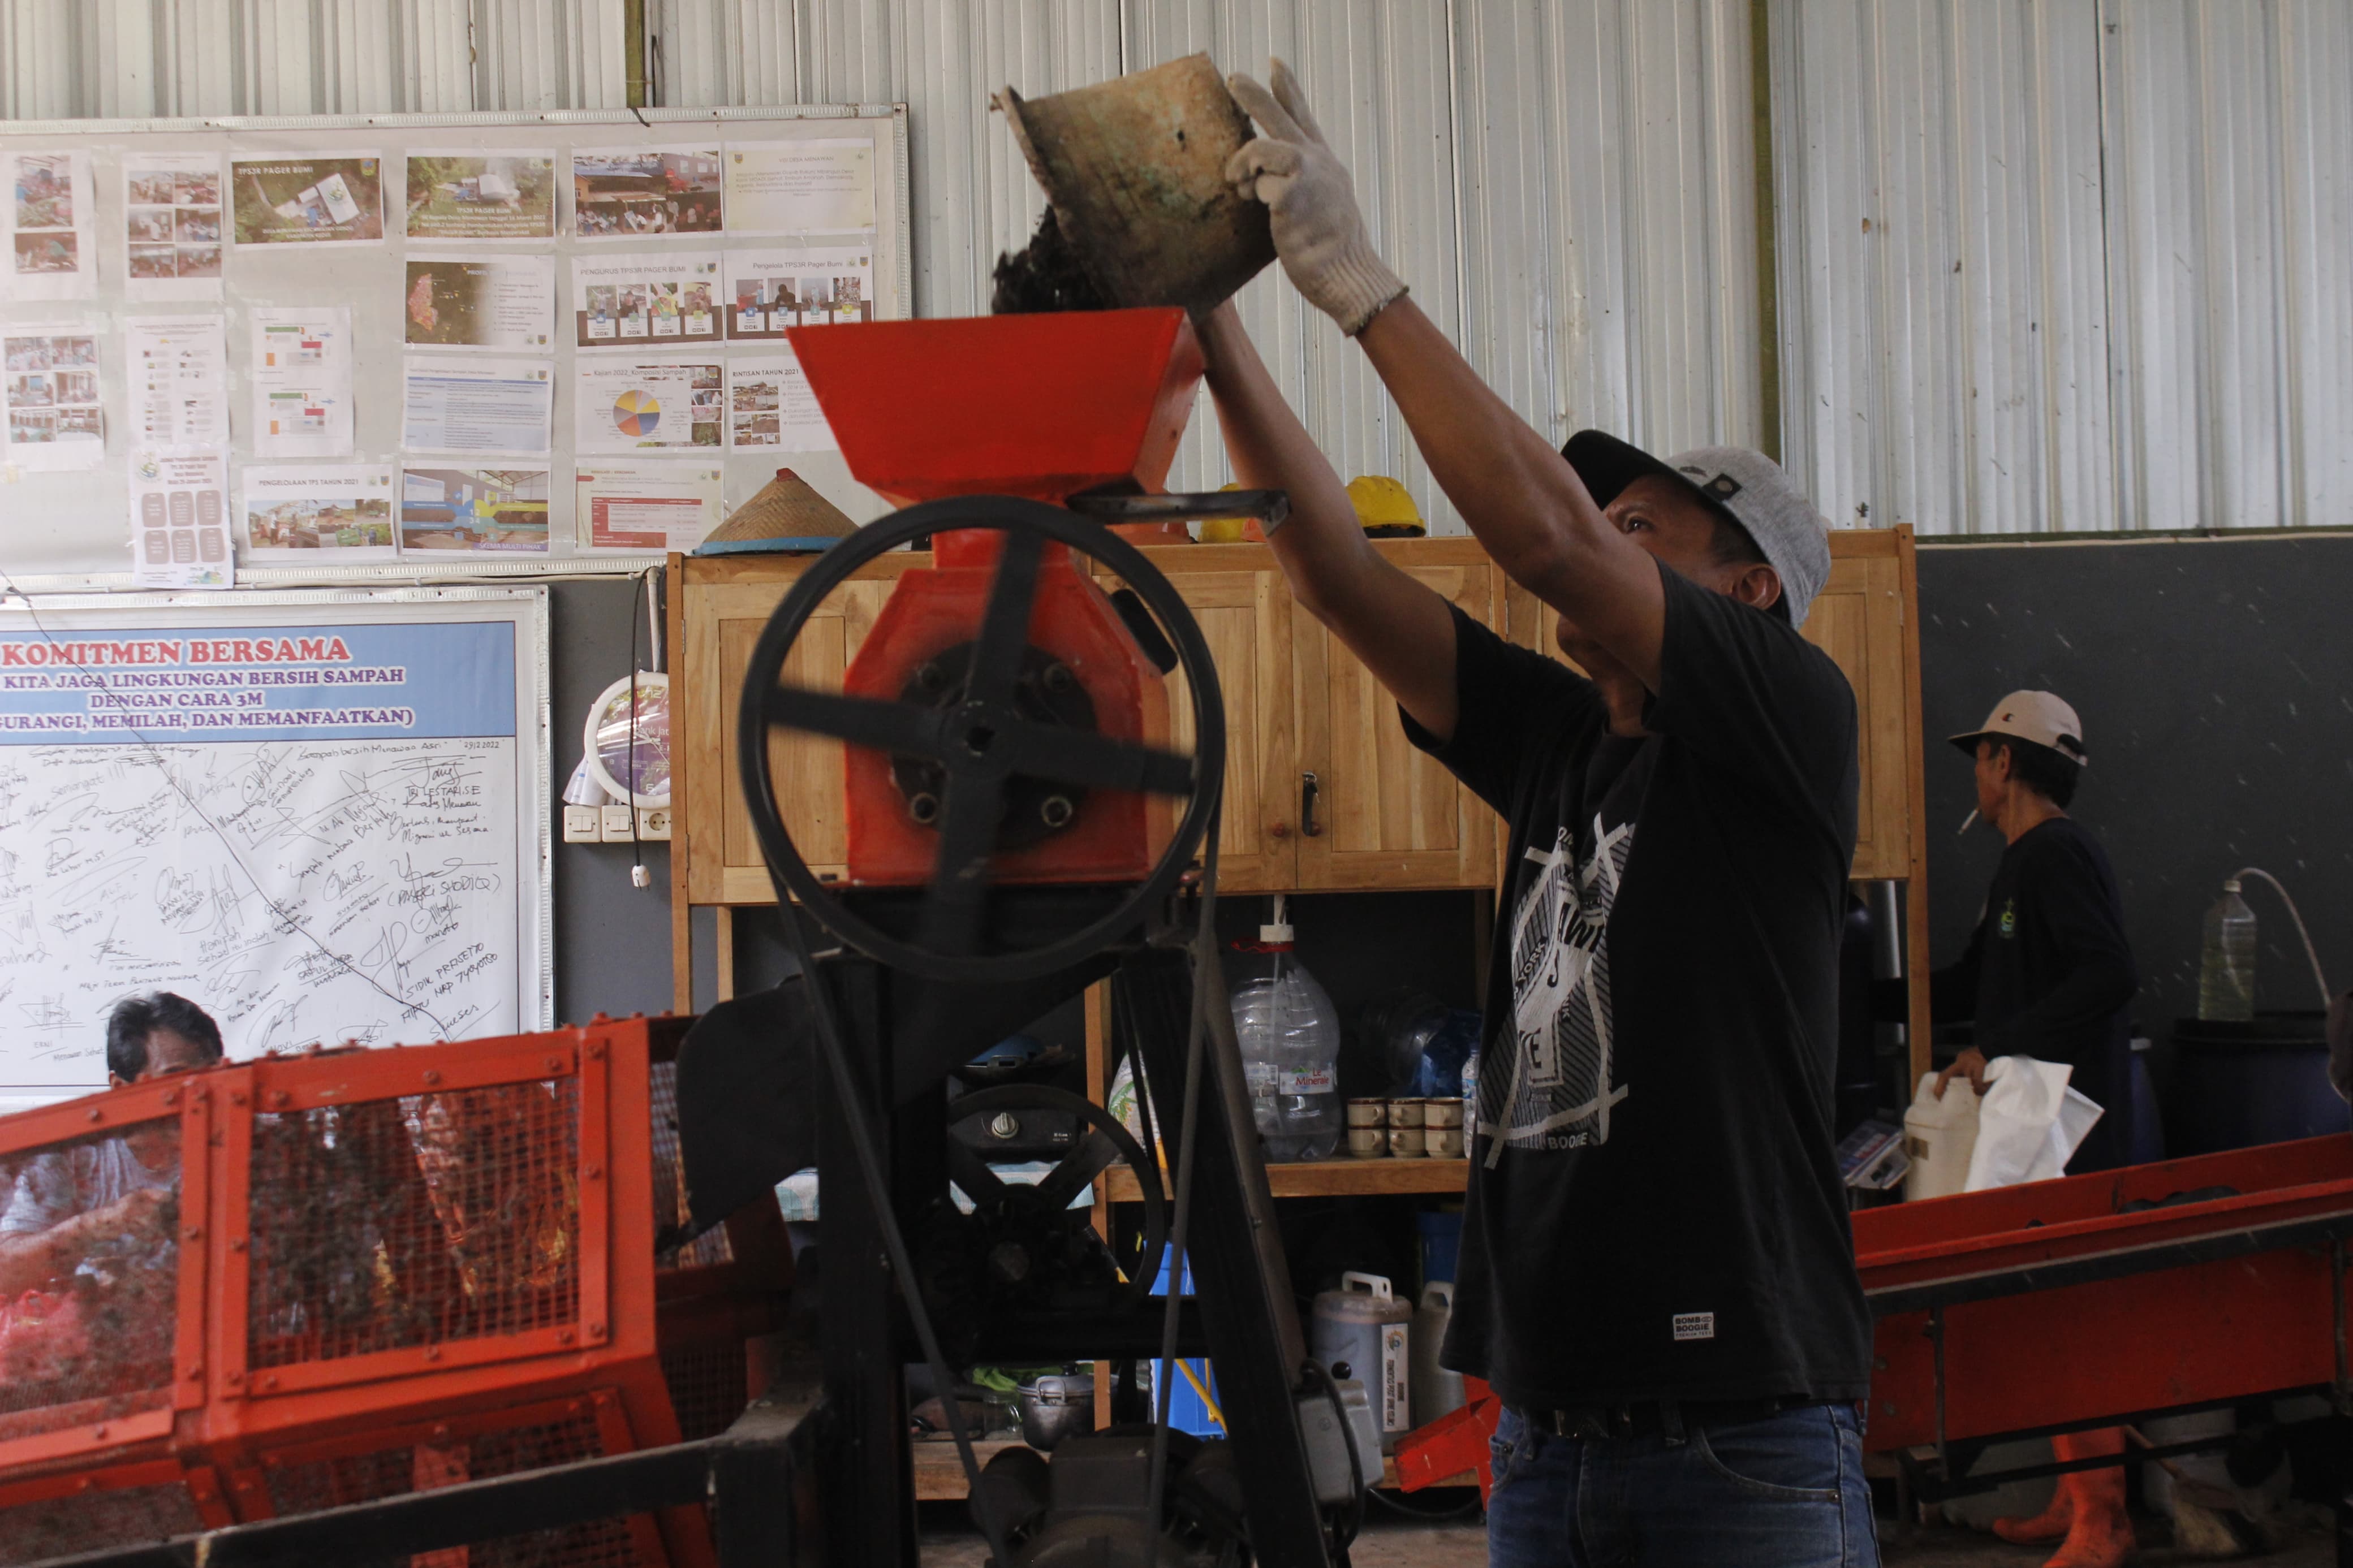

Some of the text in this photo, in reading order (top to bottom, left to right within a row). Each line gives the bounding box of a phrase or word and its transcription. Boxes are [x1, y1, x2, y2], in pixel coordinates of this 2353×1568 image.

[753, 262, 782, 270] Pengelola
[662, 369, 687, 377] Sampah
[2, 638, 350, 666] KOMITMEN BERSAMA
[5, 669, 404, 689] KITA JAGA LINGKUNGAN BERSIH SAMPAH
[91, 692, 262, 708] DENGAN CARA 3M
[92, 713, 187, 729] MEMILAH,
[192, 712, 233, 727] DAN
[240, 709, 413, 727] MEMANFAATKAN)
[1518, 942, 1546, 984] YORK
[406, 977, 434, 999] SIDIK
[1295, 1075, 1329, 1086] Minerale
[1313, 1068, 1321, 1077] Le
[1676, 1324, 1710, 1332] BOOGIE
